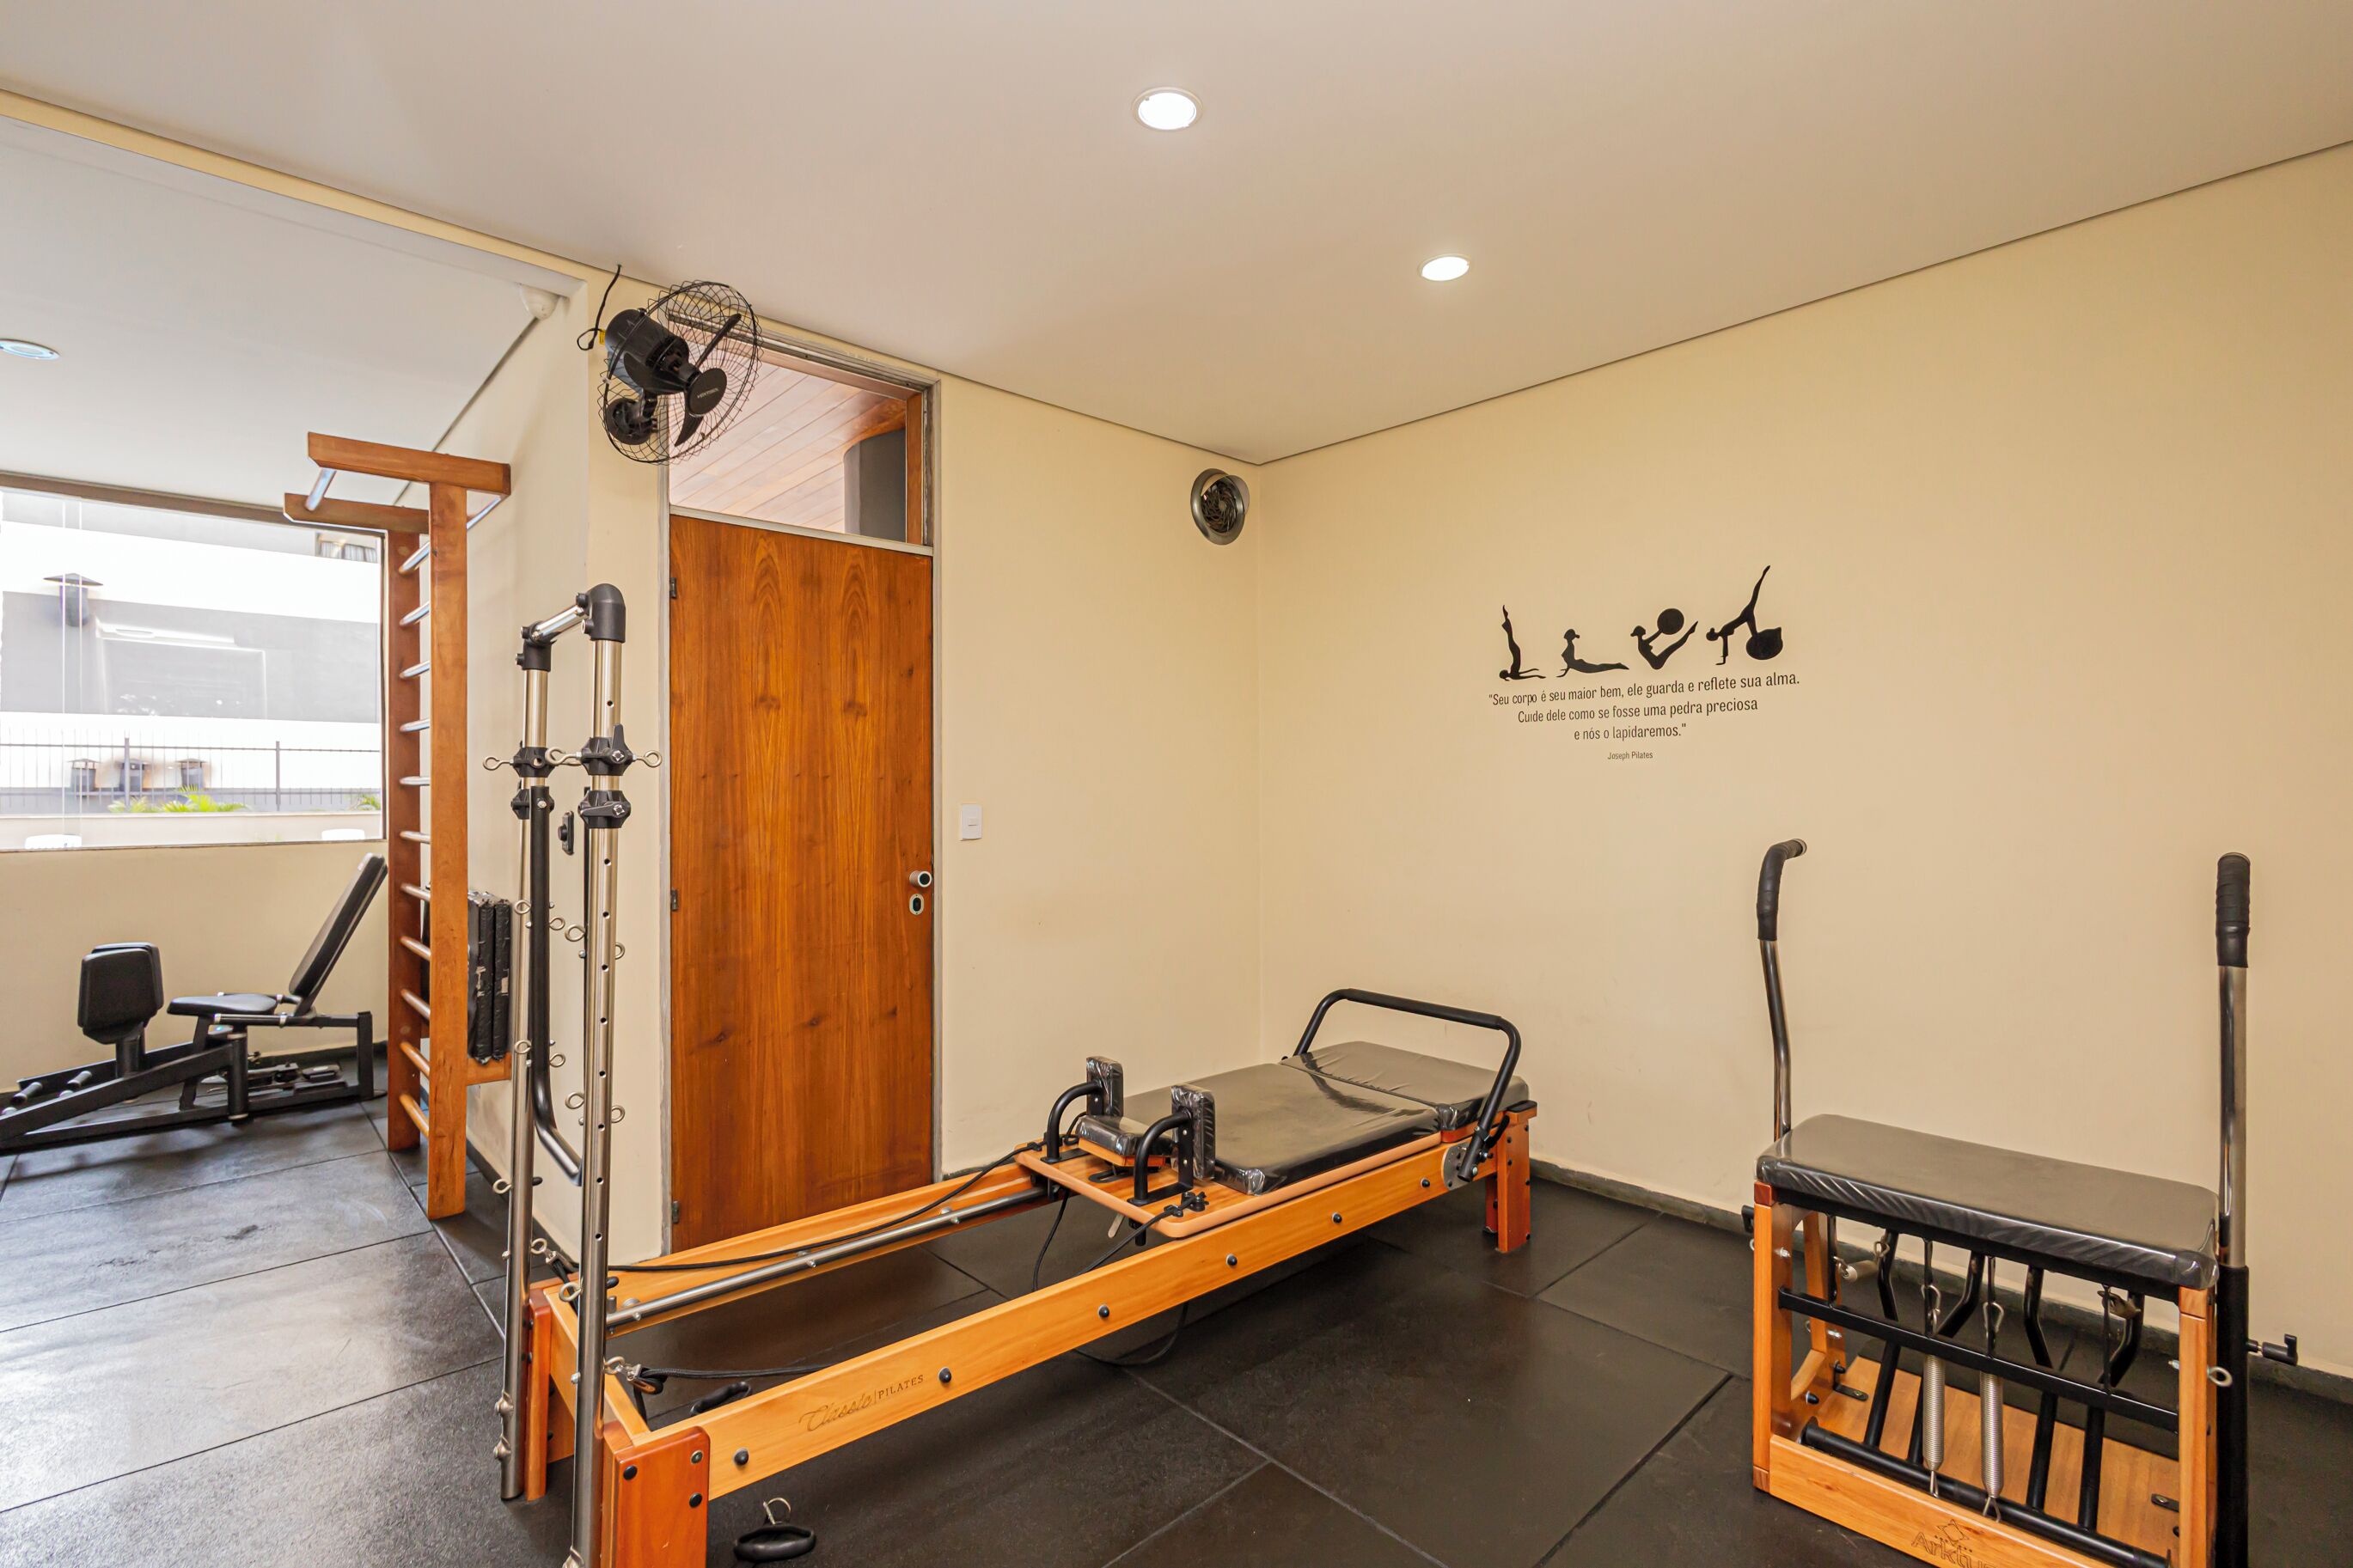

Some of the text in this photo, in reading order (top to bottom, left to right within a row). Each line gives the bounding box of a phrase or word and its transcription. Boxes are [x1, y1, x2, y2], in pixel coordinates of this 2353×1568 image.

[1488, 672, 1800, 706] "Seu corpo é seu maior bem, ele guarda e reflete sua alma.
[1546, 709, 1567, 722] dele
[1568, 710, 1595, 721] como
[1598, 709, 1610, 719] se
[1612, 705, 1641, 718] fosse
[1643, 705, 1667, 717] uma
[1670, 701, 1703, 719] pedra
[1706, 697, 1758, 717] preciosa
[1574, 723, 1687, 742] e nós o lapidaremos."
[1607, 751, 1653, 761] Joseph Pilates
[877, 1375, 925, 1400] PILATES
